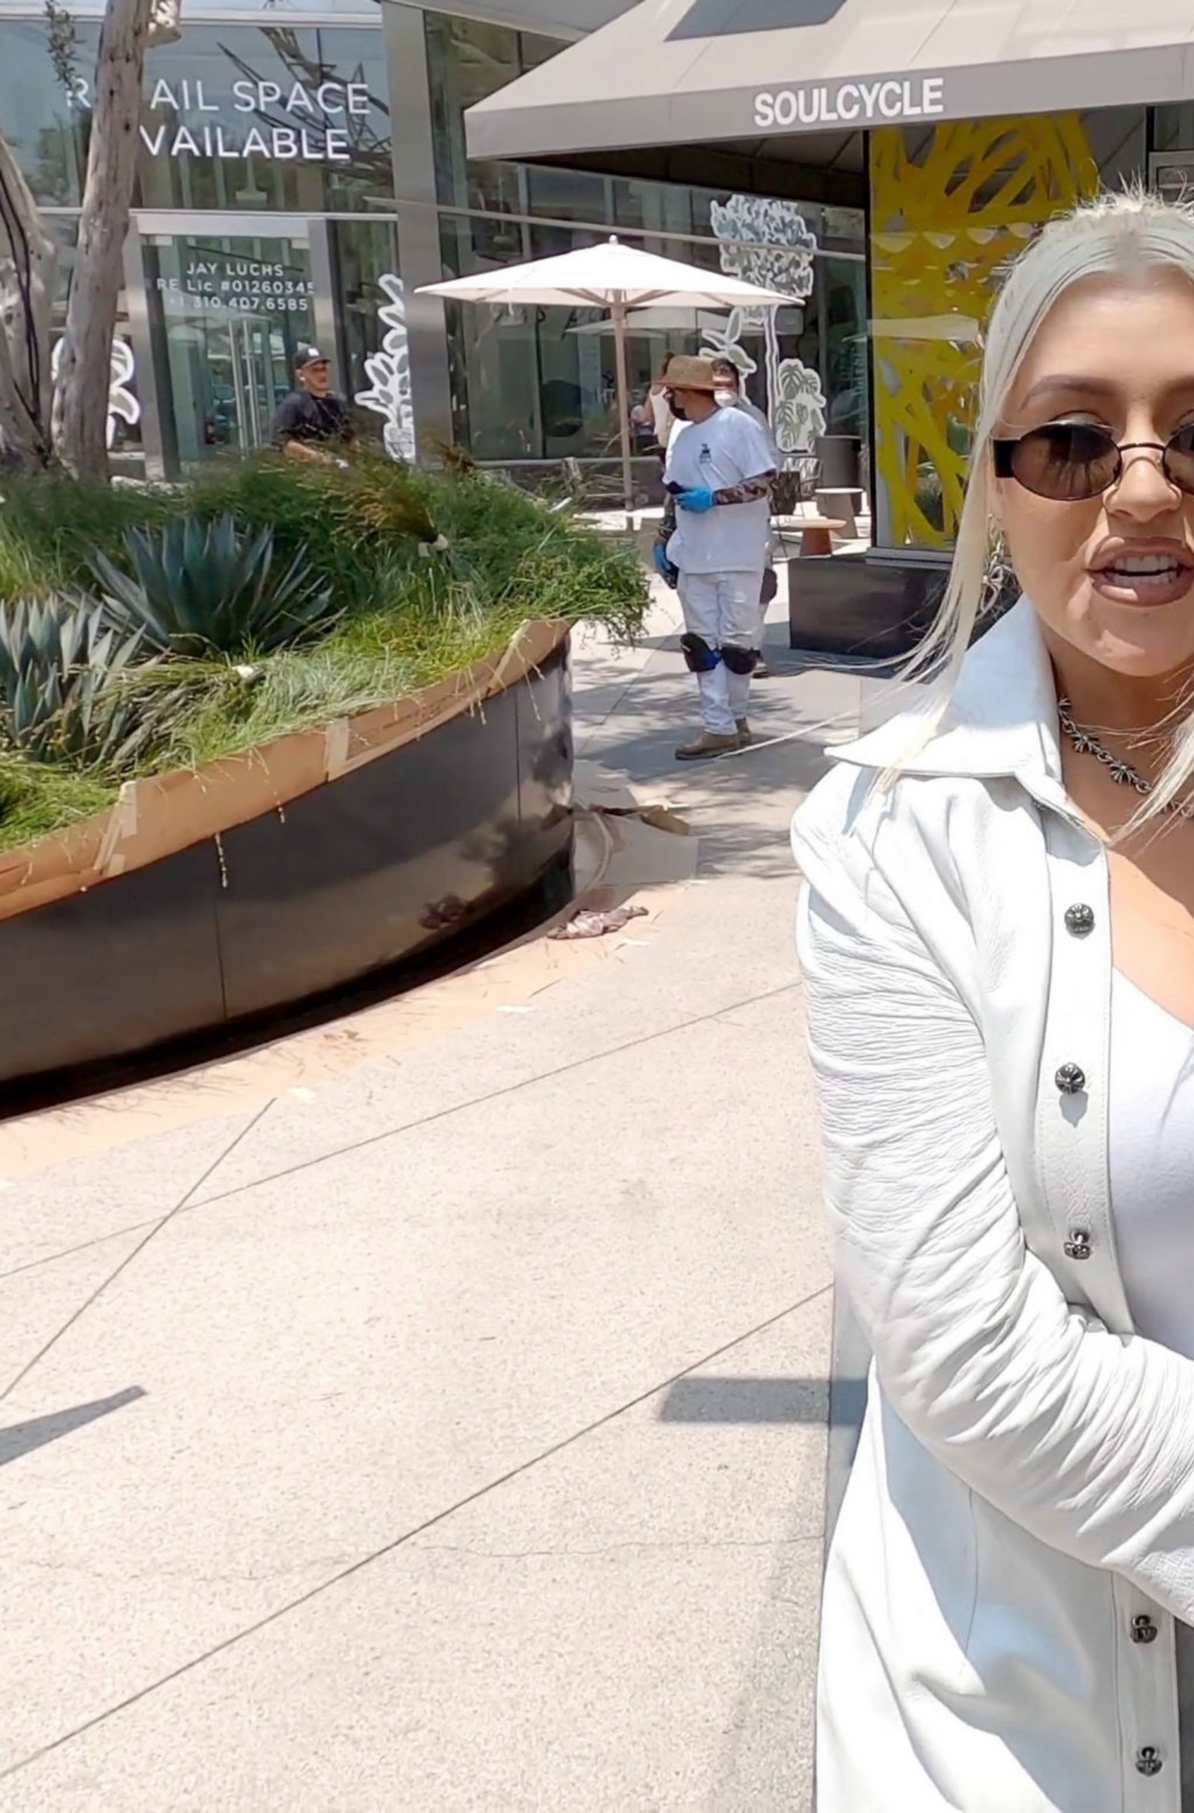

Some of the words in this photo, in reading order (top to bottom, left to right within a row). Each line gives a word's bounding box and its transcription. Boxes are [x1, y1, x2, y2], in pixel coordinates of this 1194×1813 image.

[66, 78, 219, 111] RAIL
[233, 81, 369, 114] SPACE
[753, 77, 944, 127] SOULCYCLE
[139, 126, 350, 159] VAILABLE
[187, 262, 217, 275] JAY
[226, 264, 284, 276] LUCHS
[187, 280, 213, 292] Lic
